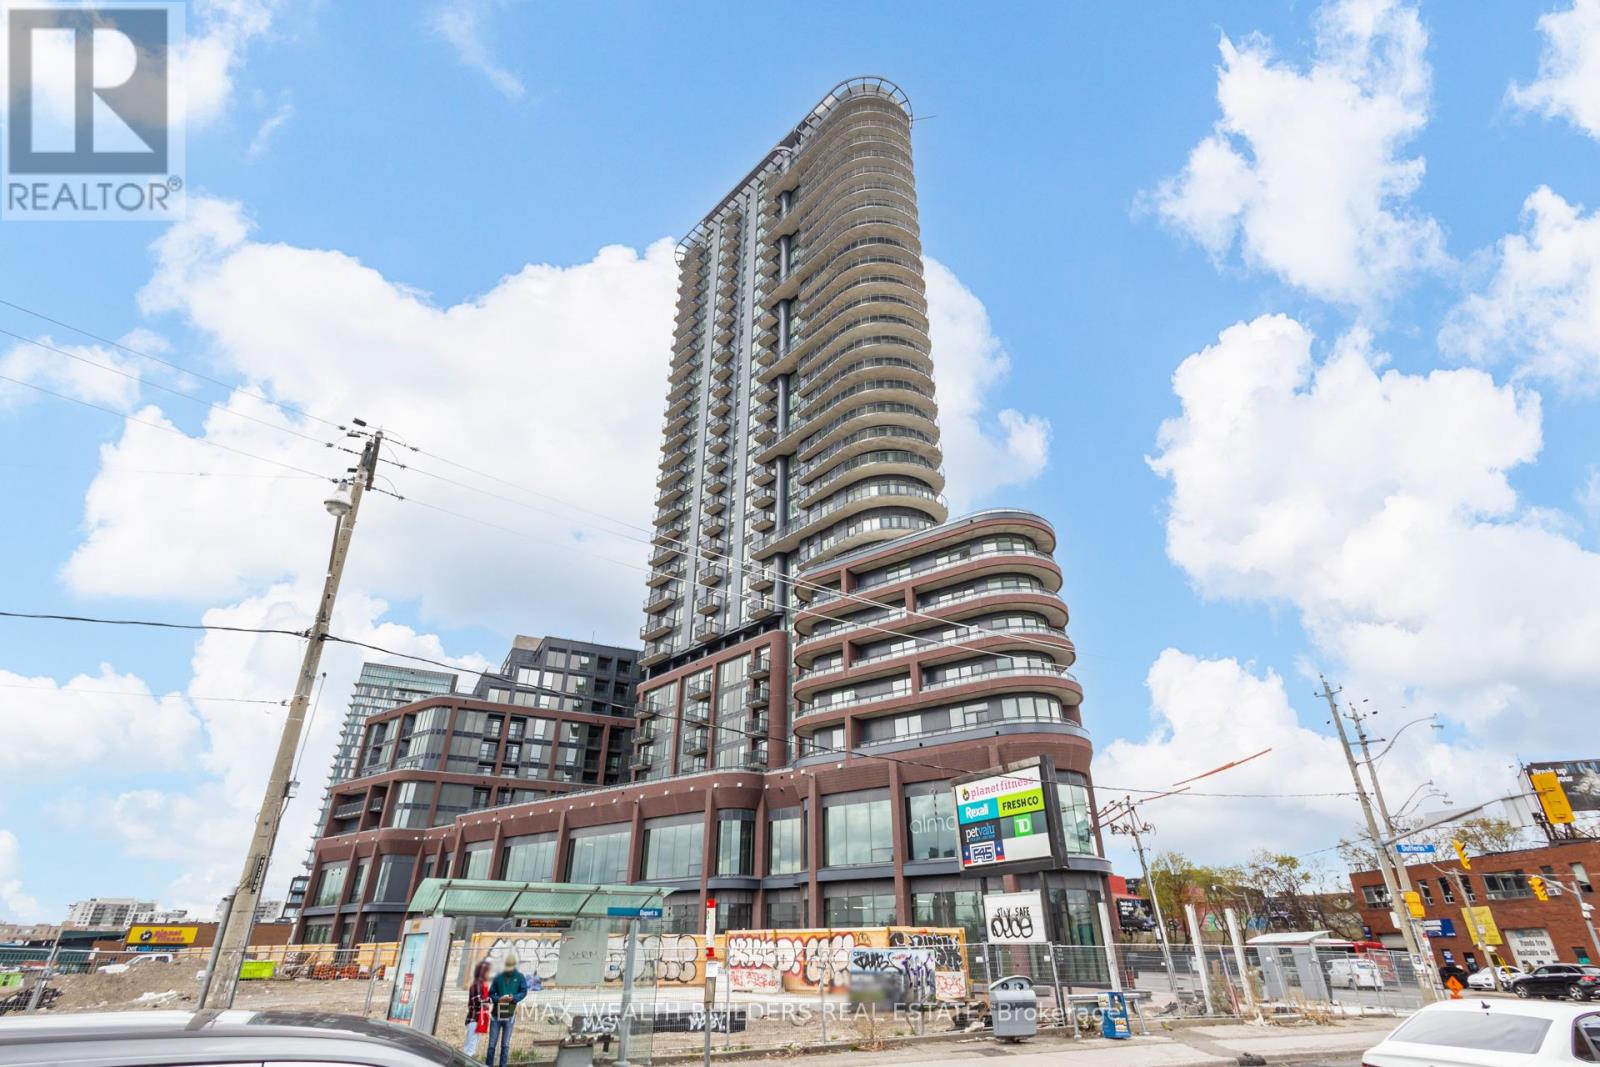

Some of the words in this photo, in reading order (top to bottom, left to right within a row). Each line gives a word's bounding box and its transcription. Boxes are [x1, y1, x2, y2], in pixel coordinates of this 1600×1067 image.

[965, 803, 989, 819] Rexall
[1016, 818, 1031, 833] TD
[1014, 906, 1031, 917] SAFE
